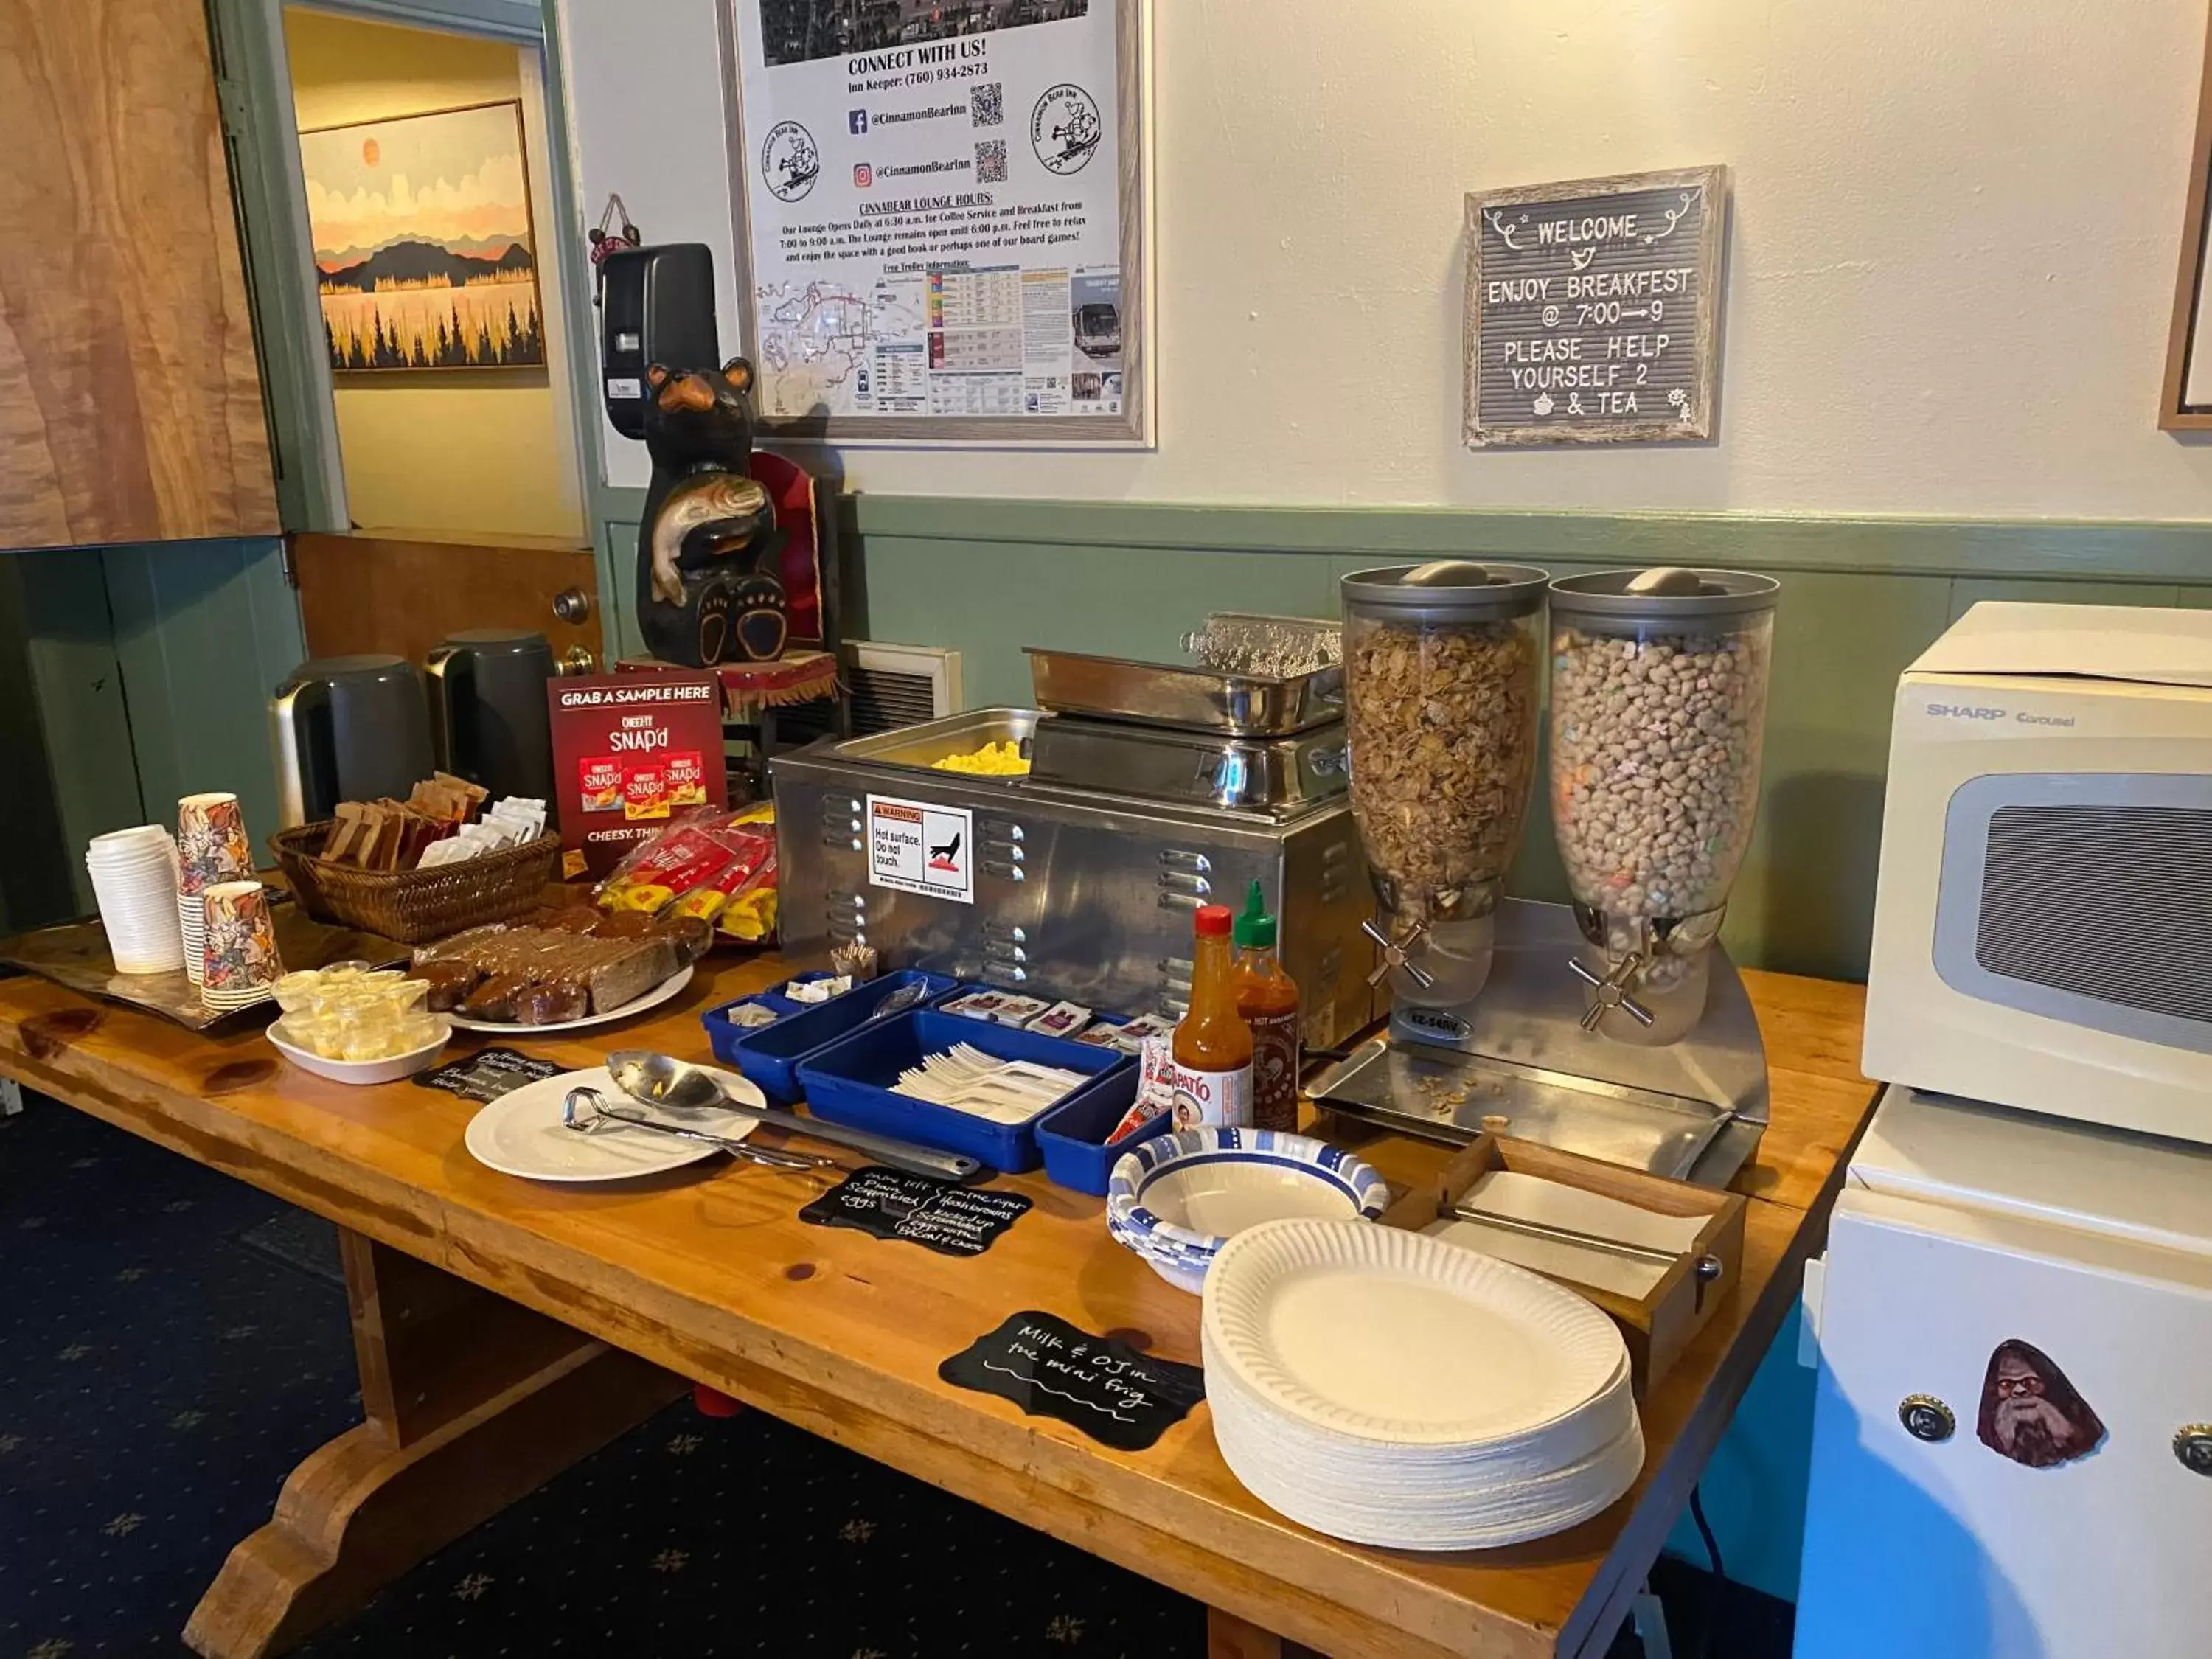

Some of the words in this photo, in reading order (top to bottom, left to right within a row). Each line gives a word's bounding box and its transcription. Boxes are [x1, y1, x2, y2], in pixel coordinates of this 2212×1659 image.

[849, 49, 914, 76] CONNECT
[918, 44, 955, 65] WITH
[961, 38, 987, 58] US!
[849, 82, 863, 93] Inn
[866, 75, 902, 91] Keeper:
[905, 71, 934, 87] (760)
[936, 63, 988, 80] 934-2873
[872, 104, 967, 125] @CinnamonBearInn
[876, 159, 971, 178] @CinnamonBearInn
[859, 198, 911, 215] CINNABEAR
[914, 195, 951, 211] LOUNGE
[956, 191, 993, 206] HOURS:
[885, 216, 903, 226] 6:30
[939, 212, 964, 222] Coffee
[967, 209, 996, 220] Service
[999, 207, 1015, 217] and
[1017, 204, 1059, 215] Breakfast
[1061, 201, 1082, 212] from
[810, 236, 827, 247] 9:00
[848, 234, 862, 243] The
[863, 232, 891, 243] Lounge
[928, 229, 947, 239] open
[970, 223, 990, 234] 6:00
[1013, 220, 1031, 231] Feel
[1033, 219, 1050, 229] free
[1064, 216, 1086, 226] relax
[1538, 215, 1638, 244] WELCOME
[785, 253, 800, 262] and
[824, 249, 835, 259] the
[861, 246, 878, 257] with
[887, 246, 906, 257] good
[940, 240, 973, 251] perhaps
[975, 239, 990, 248] one
[992, 237, 1001, 247] of
[1003, 237, 1018, 246] our
[1020, 234, 1045, 245] board
[1048, 231, 1080, 244] games!
[1489, 277, 1551, 304] ENJOY
[1568, 268, 1693, 299] BREAKFEST
[1542, 305, 1559, 327] @
[1504, 338, 1582, 364] PLEASE
[1607, 334, 1670, 359] HELP
[1511, 364, 1621, 391] YOURSELF
[1635, 364, 1648, 386] 2
[1568, 392, 1585, 416] &
[1597, 392, 1638, 414] TEA
[561, 692, 602, 706] GRAB
[602, 692, 614, 703] A
[616, 687, 672, 703] SAMPLE
[674, 686, 710, 700] HERE
[1926, 703, 2006, 720] SHARP
[2016, 712, 2076, 727] Carousel
[882, 806, 921, 821] WARNING
[875, 828, 888, 840] Hot
[890, 832, 921, 846] surface.
[876, 841, 886, 852] Do
[888, 844, 900, 855] not
[1008, 1342, 1039, 1362] the
[1046, 1359, 1099, 1382] mini
[1018, 1325, 1062, 1349] Milk
[1092, 1355, 1130, 1374] OJ
[1130, 1369, 1156, 1383] in
